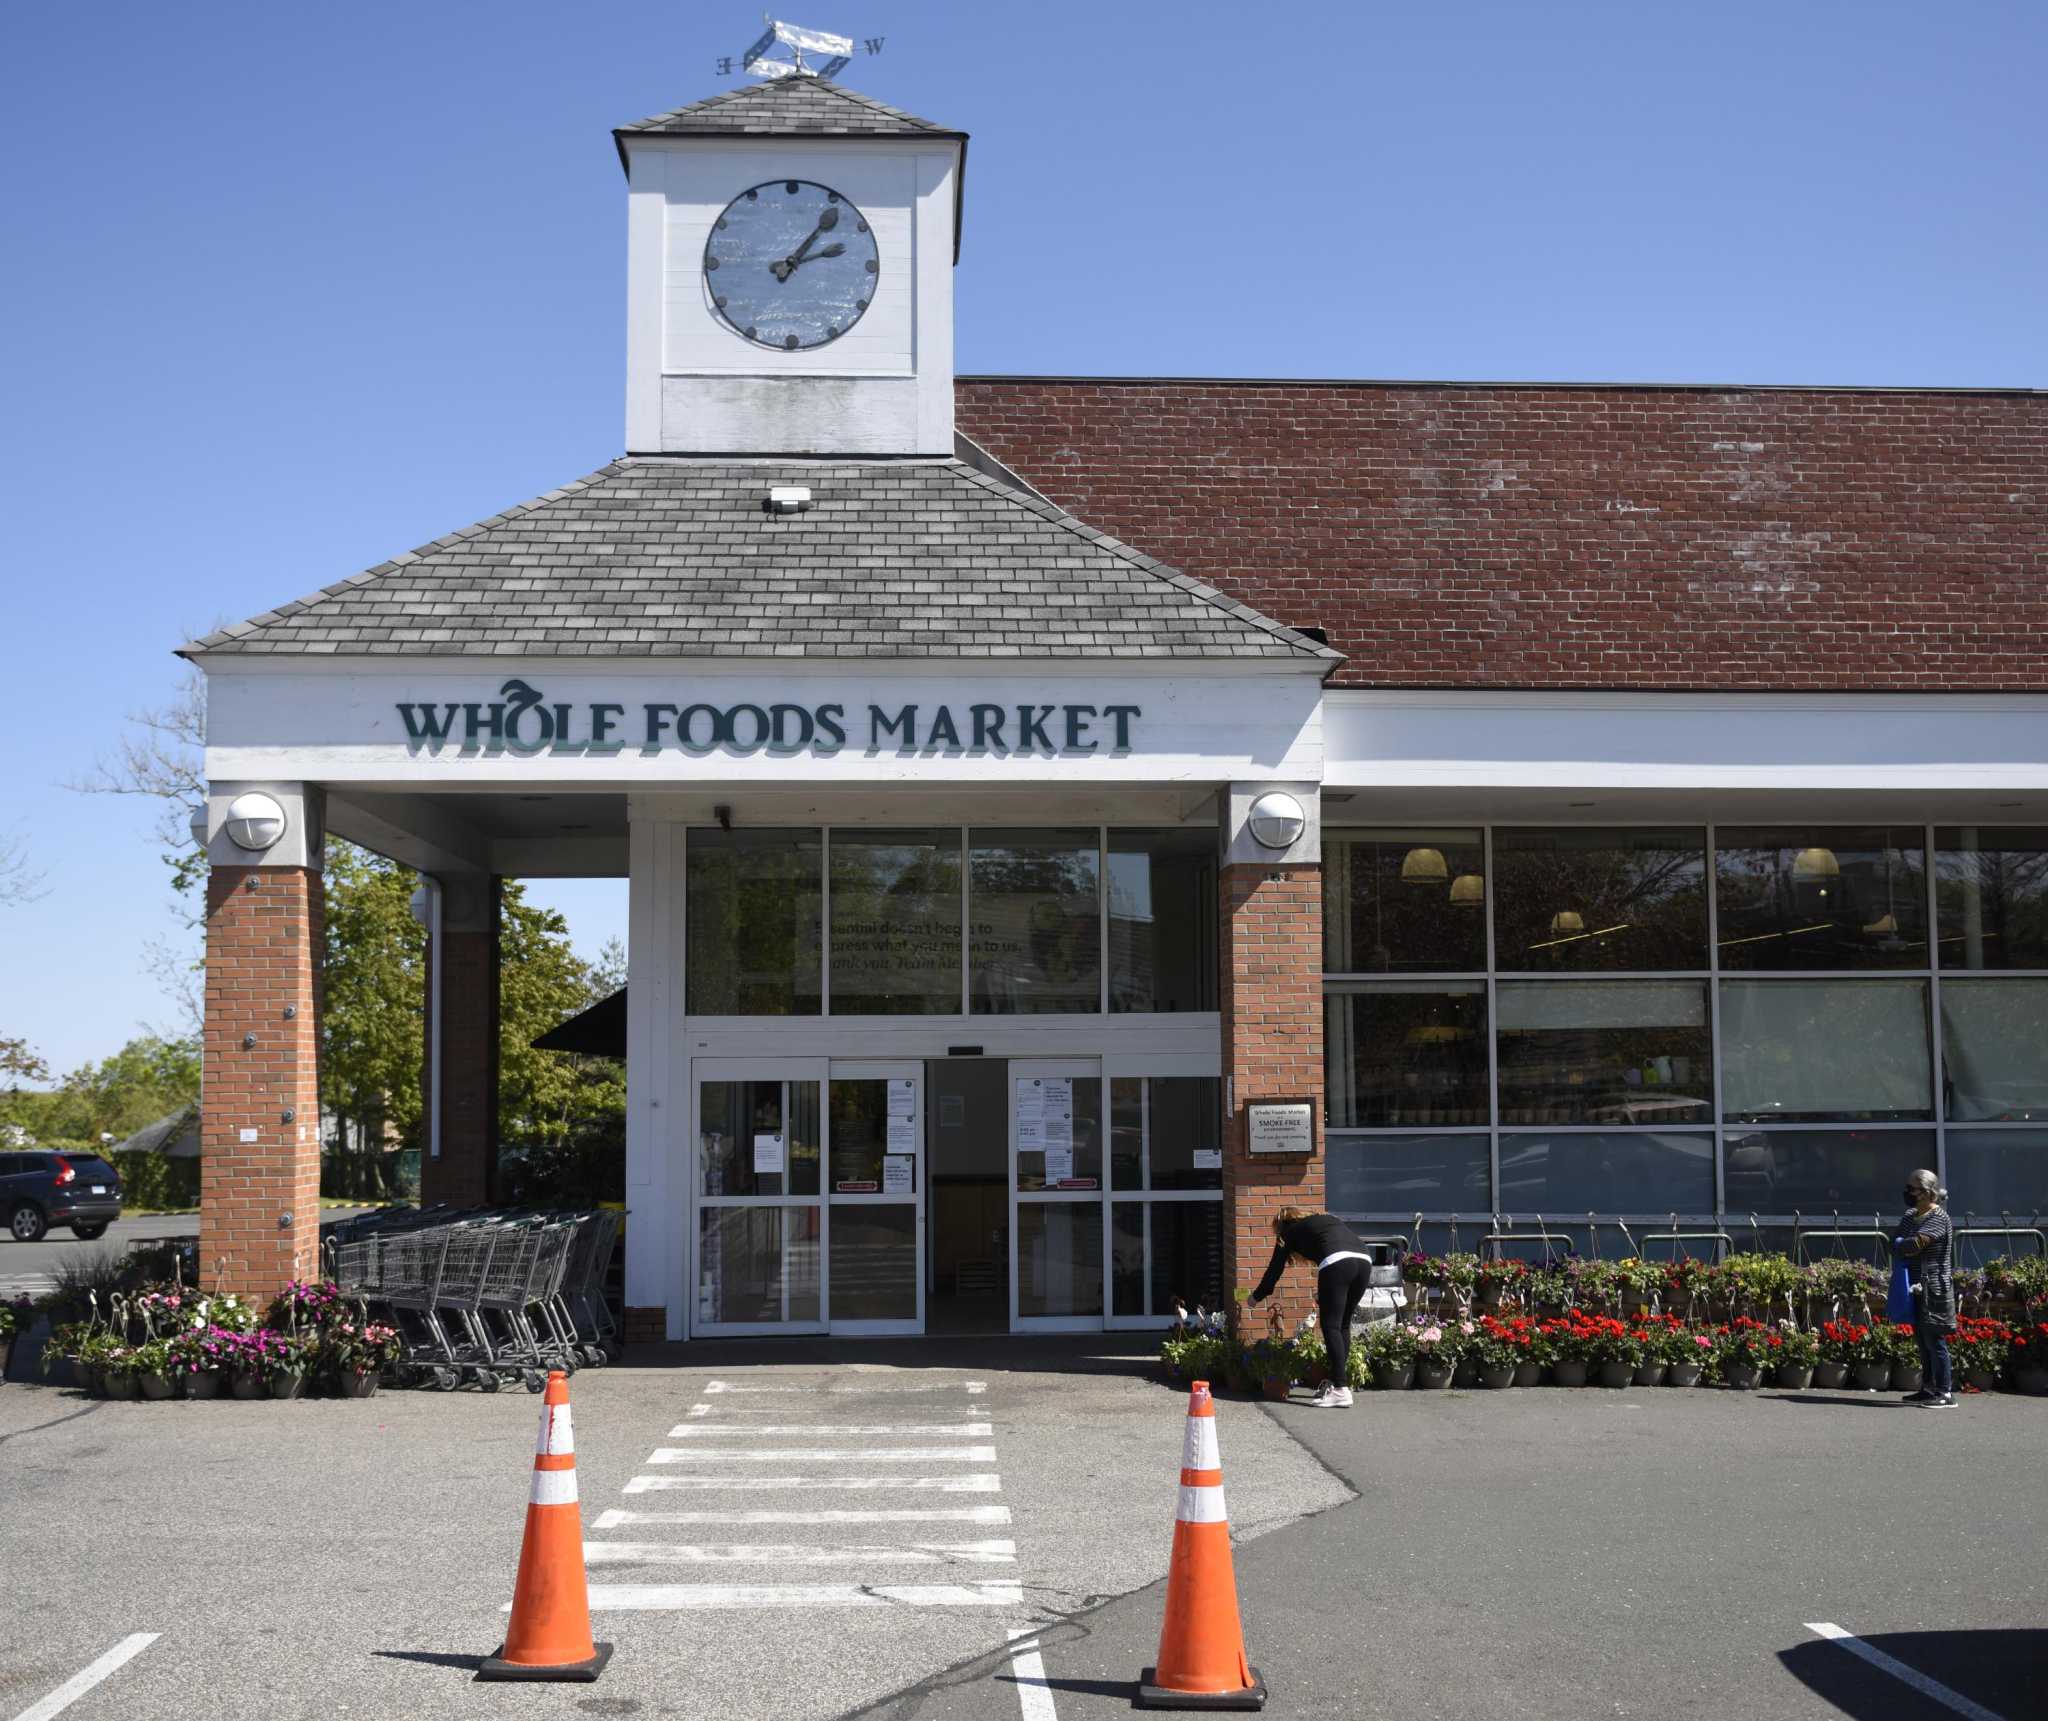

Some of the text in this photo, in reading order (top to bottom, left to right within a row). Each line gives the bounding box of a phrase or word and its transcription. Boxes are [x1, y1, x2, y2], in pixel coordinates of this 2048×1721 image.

[864, 37, 885, 56] W
[396, 680, 1142, 754] WHOLE FOODS MARKET
[816, 921, 877, 935] Esential
[935, 921, 975, 938] begn
[978, 922, 993, 935] to
[816, 942, 867, 955] epress
[941, 942, 981, 952] men
[984, 940, 999, 952] to
